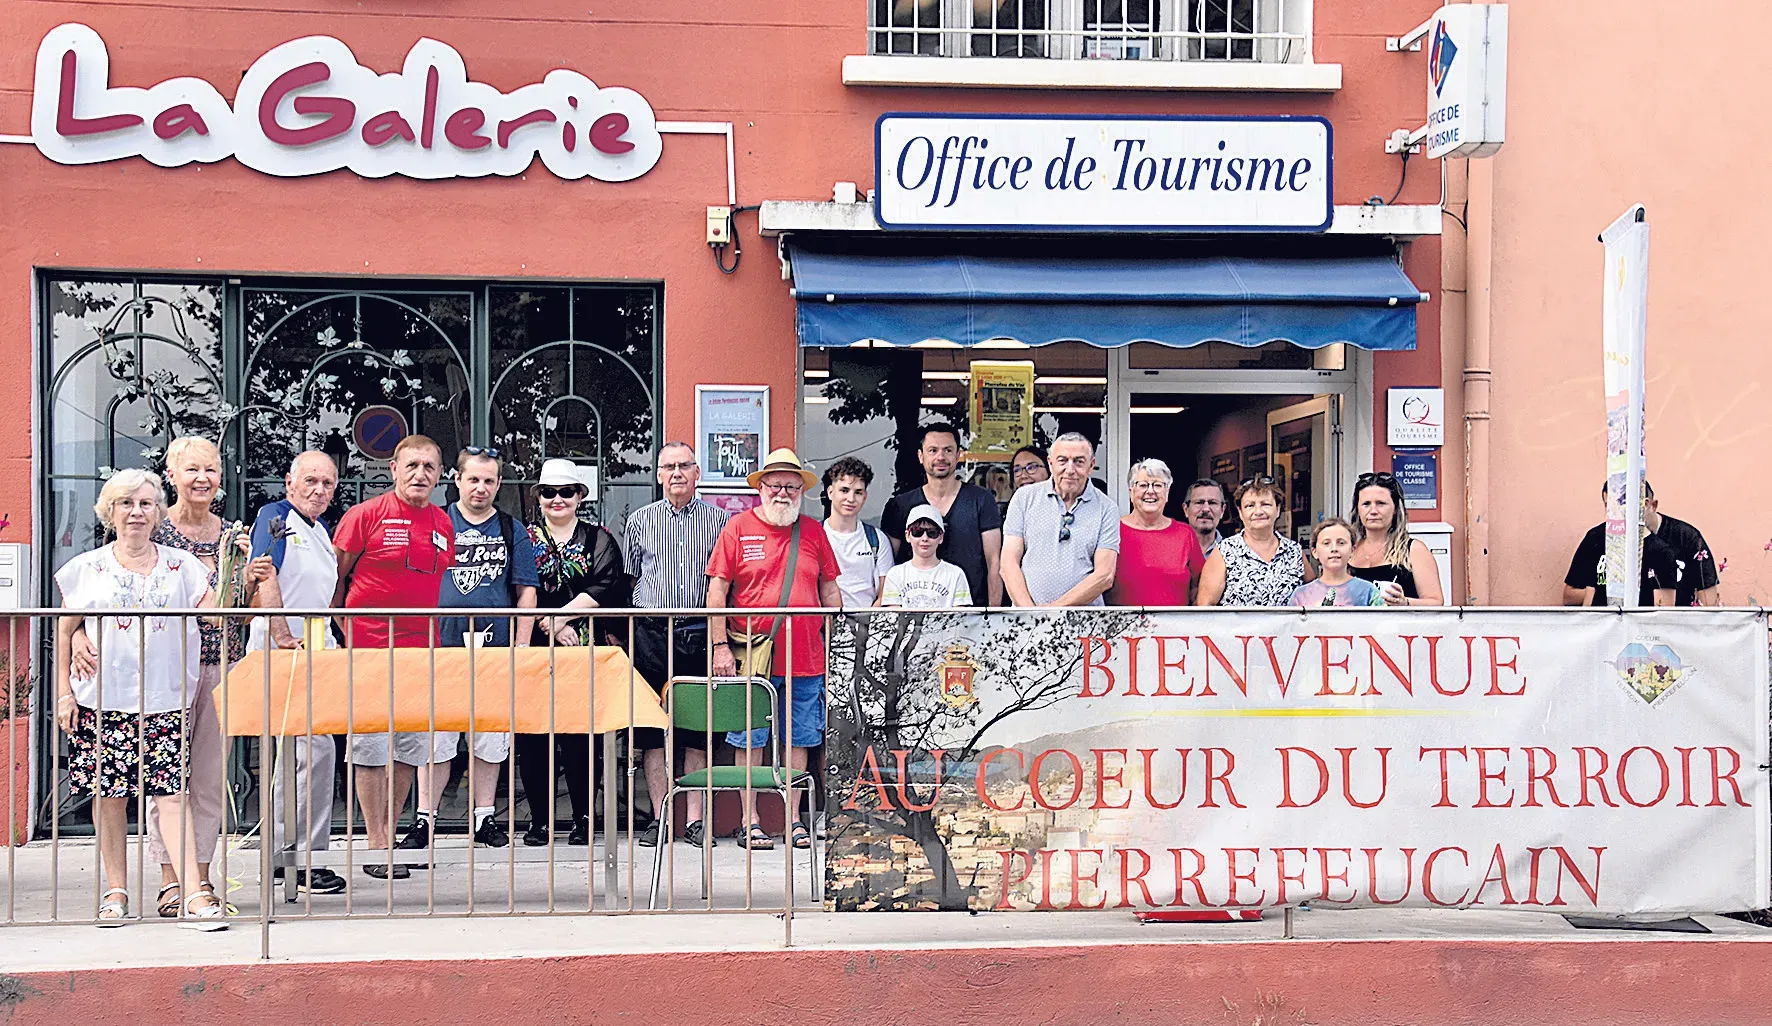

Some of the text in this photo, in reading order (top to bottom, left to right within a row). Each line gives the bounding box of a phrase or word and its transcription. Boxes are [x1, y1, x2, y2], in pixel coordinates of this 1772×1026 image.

[56, 49, 636, 154] La Galerie
[1447, 104, 1460, 120] DE
[1428, 128, 1460, 150] OURISME
[896, 136, 1312, 208] Office de Tourisme
[472, 546, 506, 563] Rock
[931, 581, 950, 598] TRIP
[947, 671, 967, 680] P F
[1076, 634, 1527, 699] BIENVENUE
[842, 744, 1753, 812] AU COEUR DU TERROIR
[996, 842, 1608, 911] PIERREFEUCAIN
